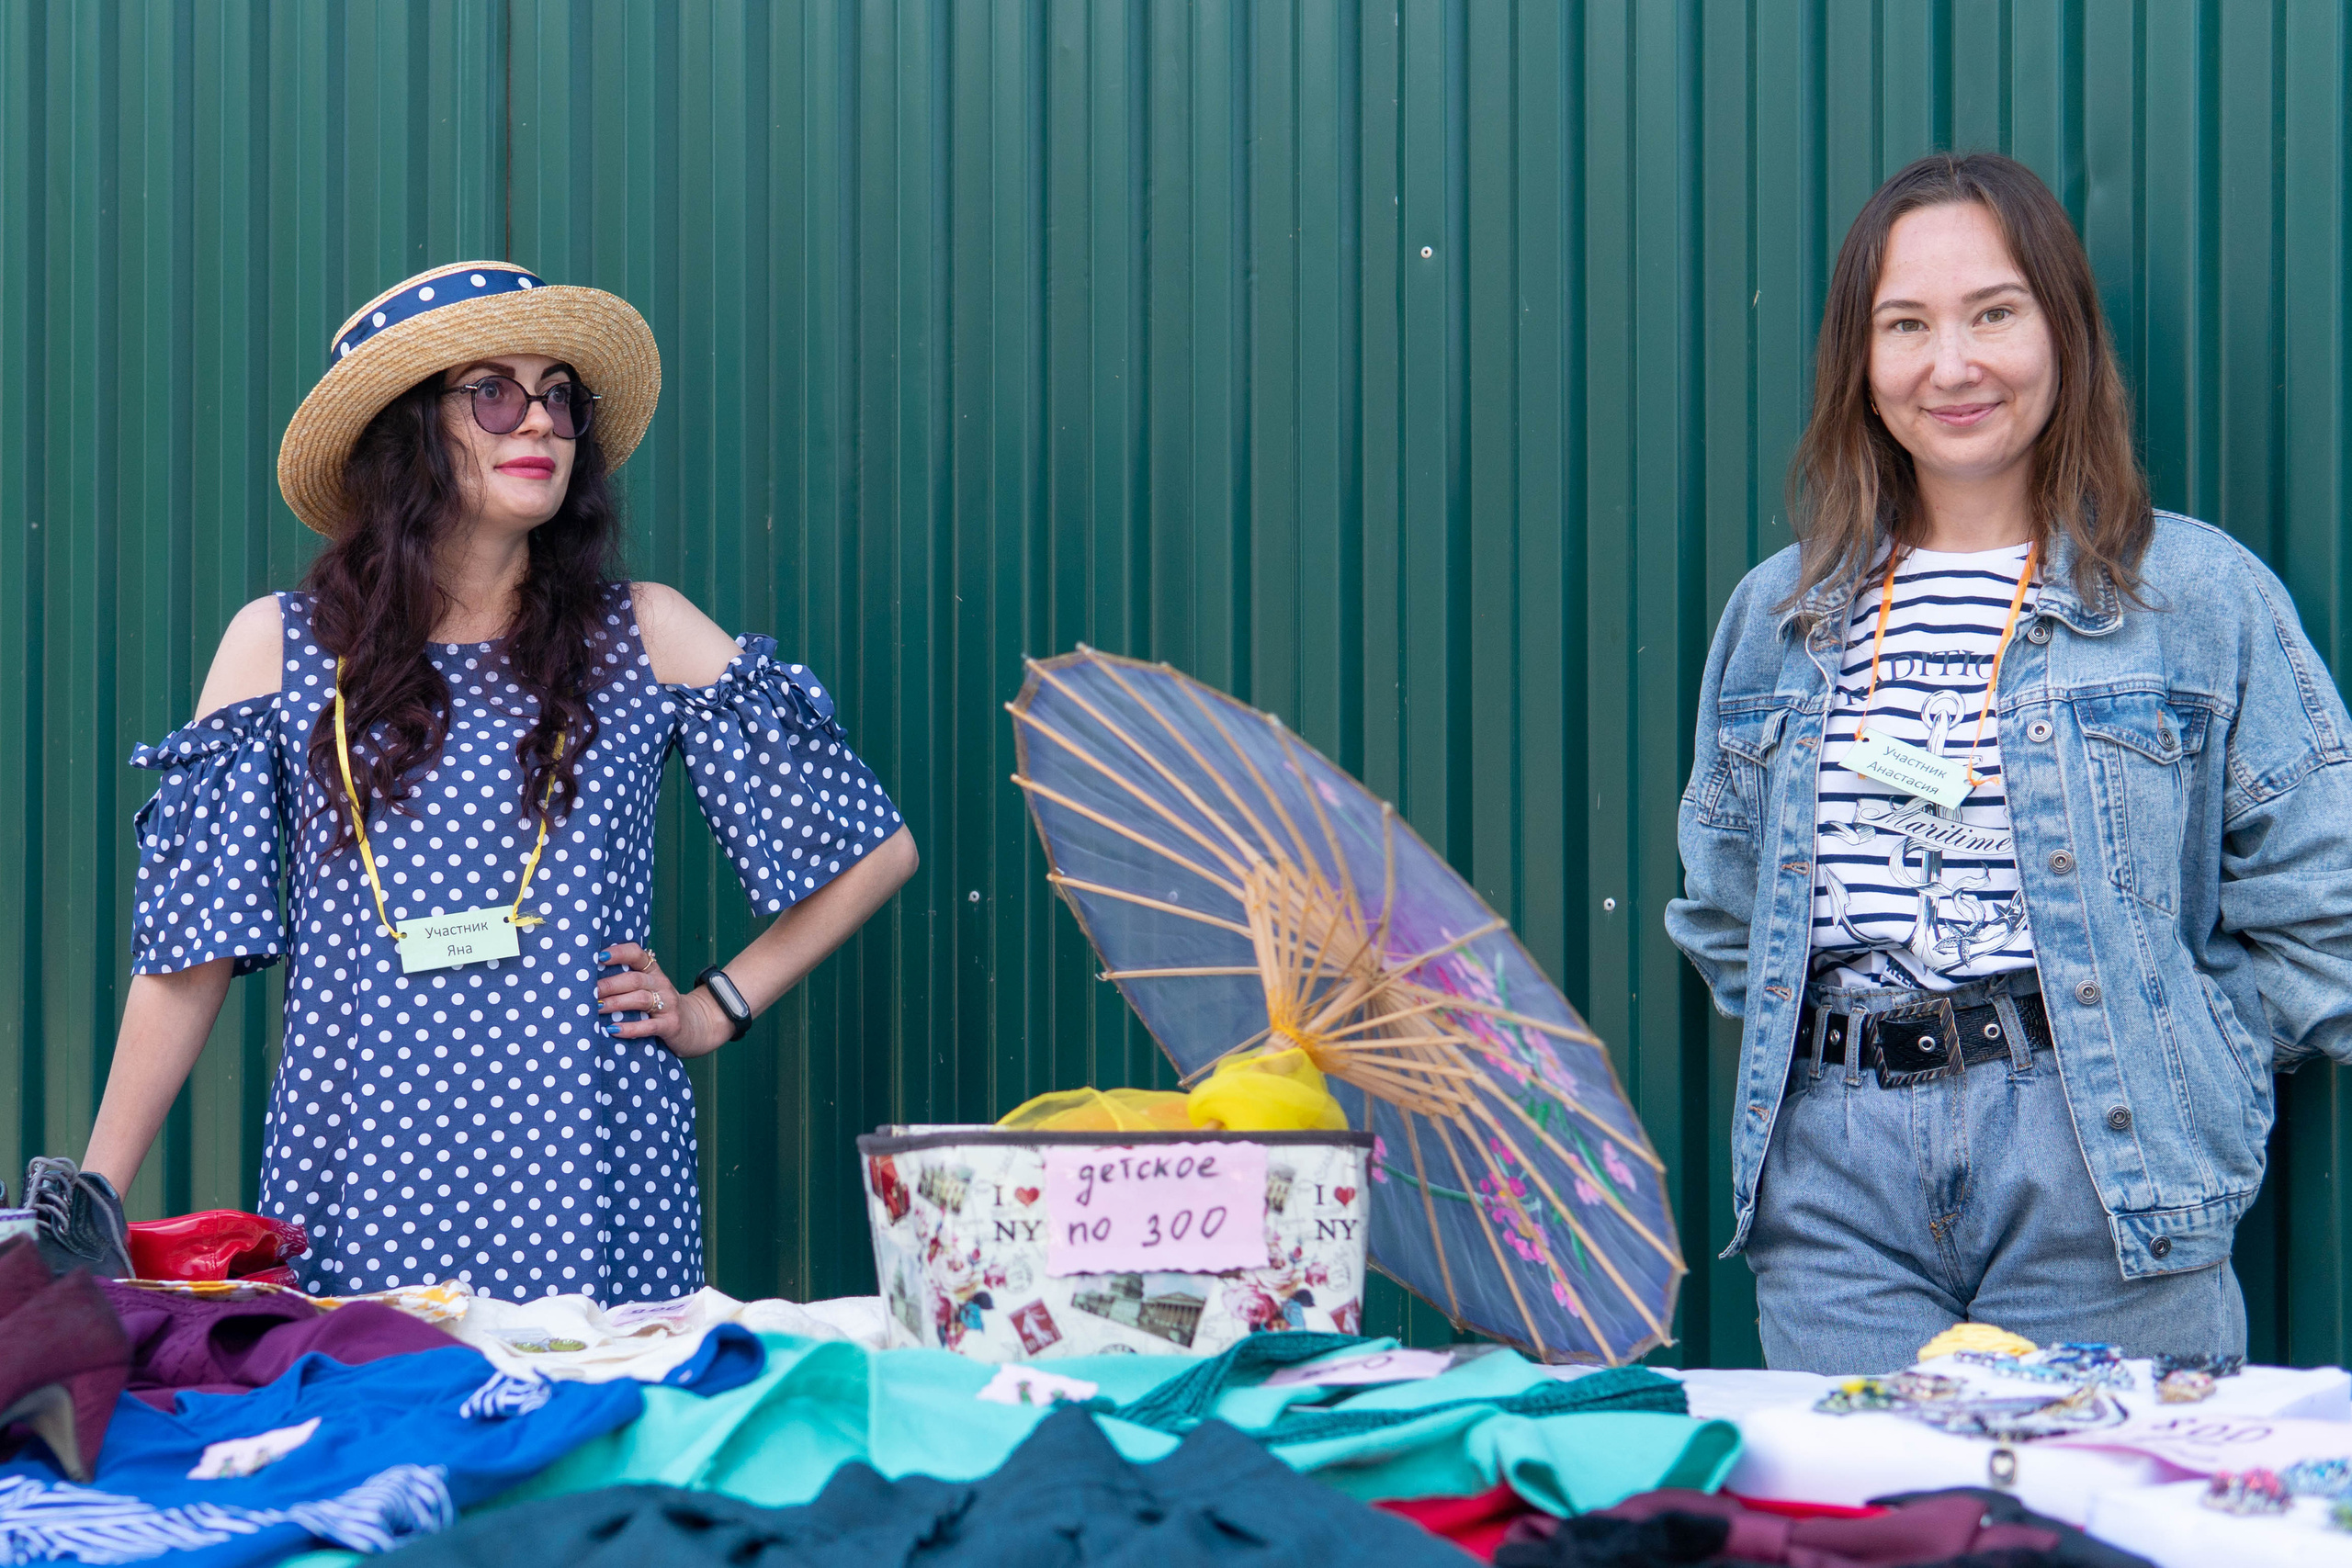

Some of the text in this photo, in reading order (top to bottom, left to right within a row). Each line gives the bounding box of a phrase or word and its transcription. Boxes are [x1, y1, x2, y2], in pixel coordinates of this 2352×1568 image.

[1883, 745, 1948, 779] Участник
[1867, 761, 1939, 795] Анастасия
[1860, 808, 2013, 852] Maritime
[424, 921, 488, 939] Участник
[447, 944, 473, 957] Яна
[1076, 1156, 1220, 1207] детское
[993, 1184, 1003, 1207] I
[1315, 1183, 1325, 1206] I
[993, 1220, 1043, 1242] NY
[1069, 1206, 1227, 1248] по 300
[1315, 1219, 1359, 1240] NY
